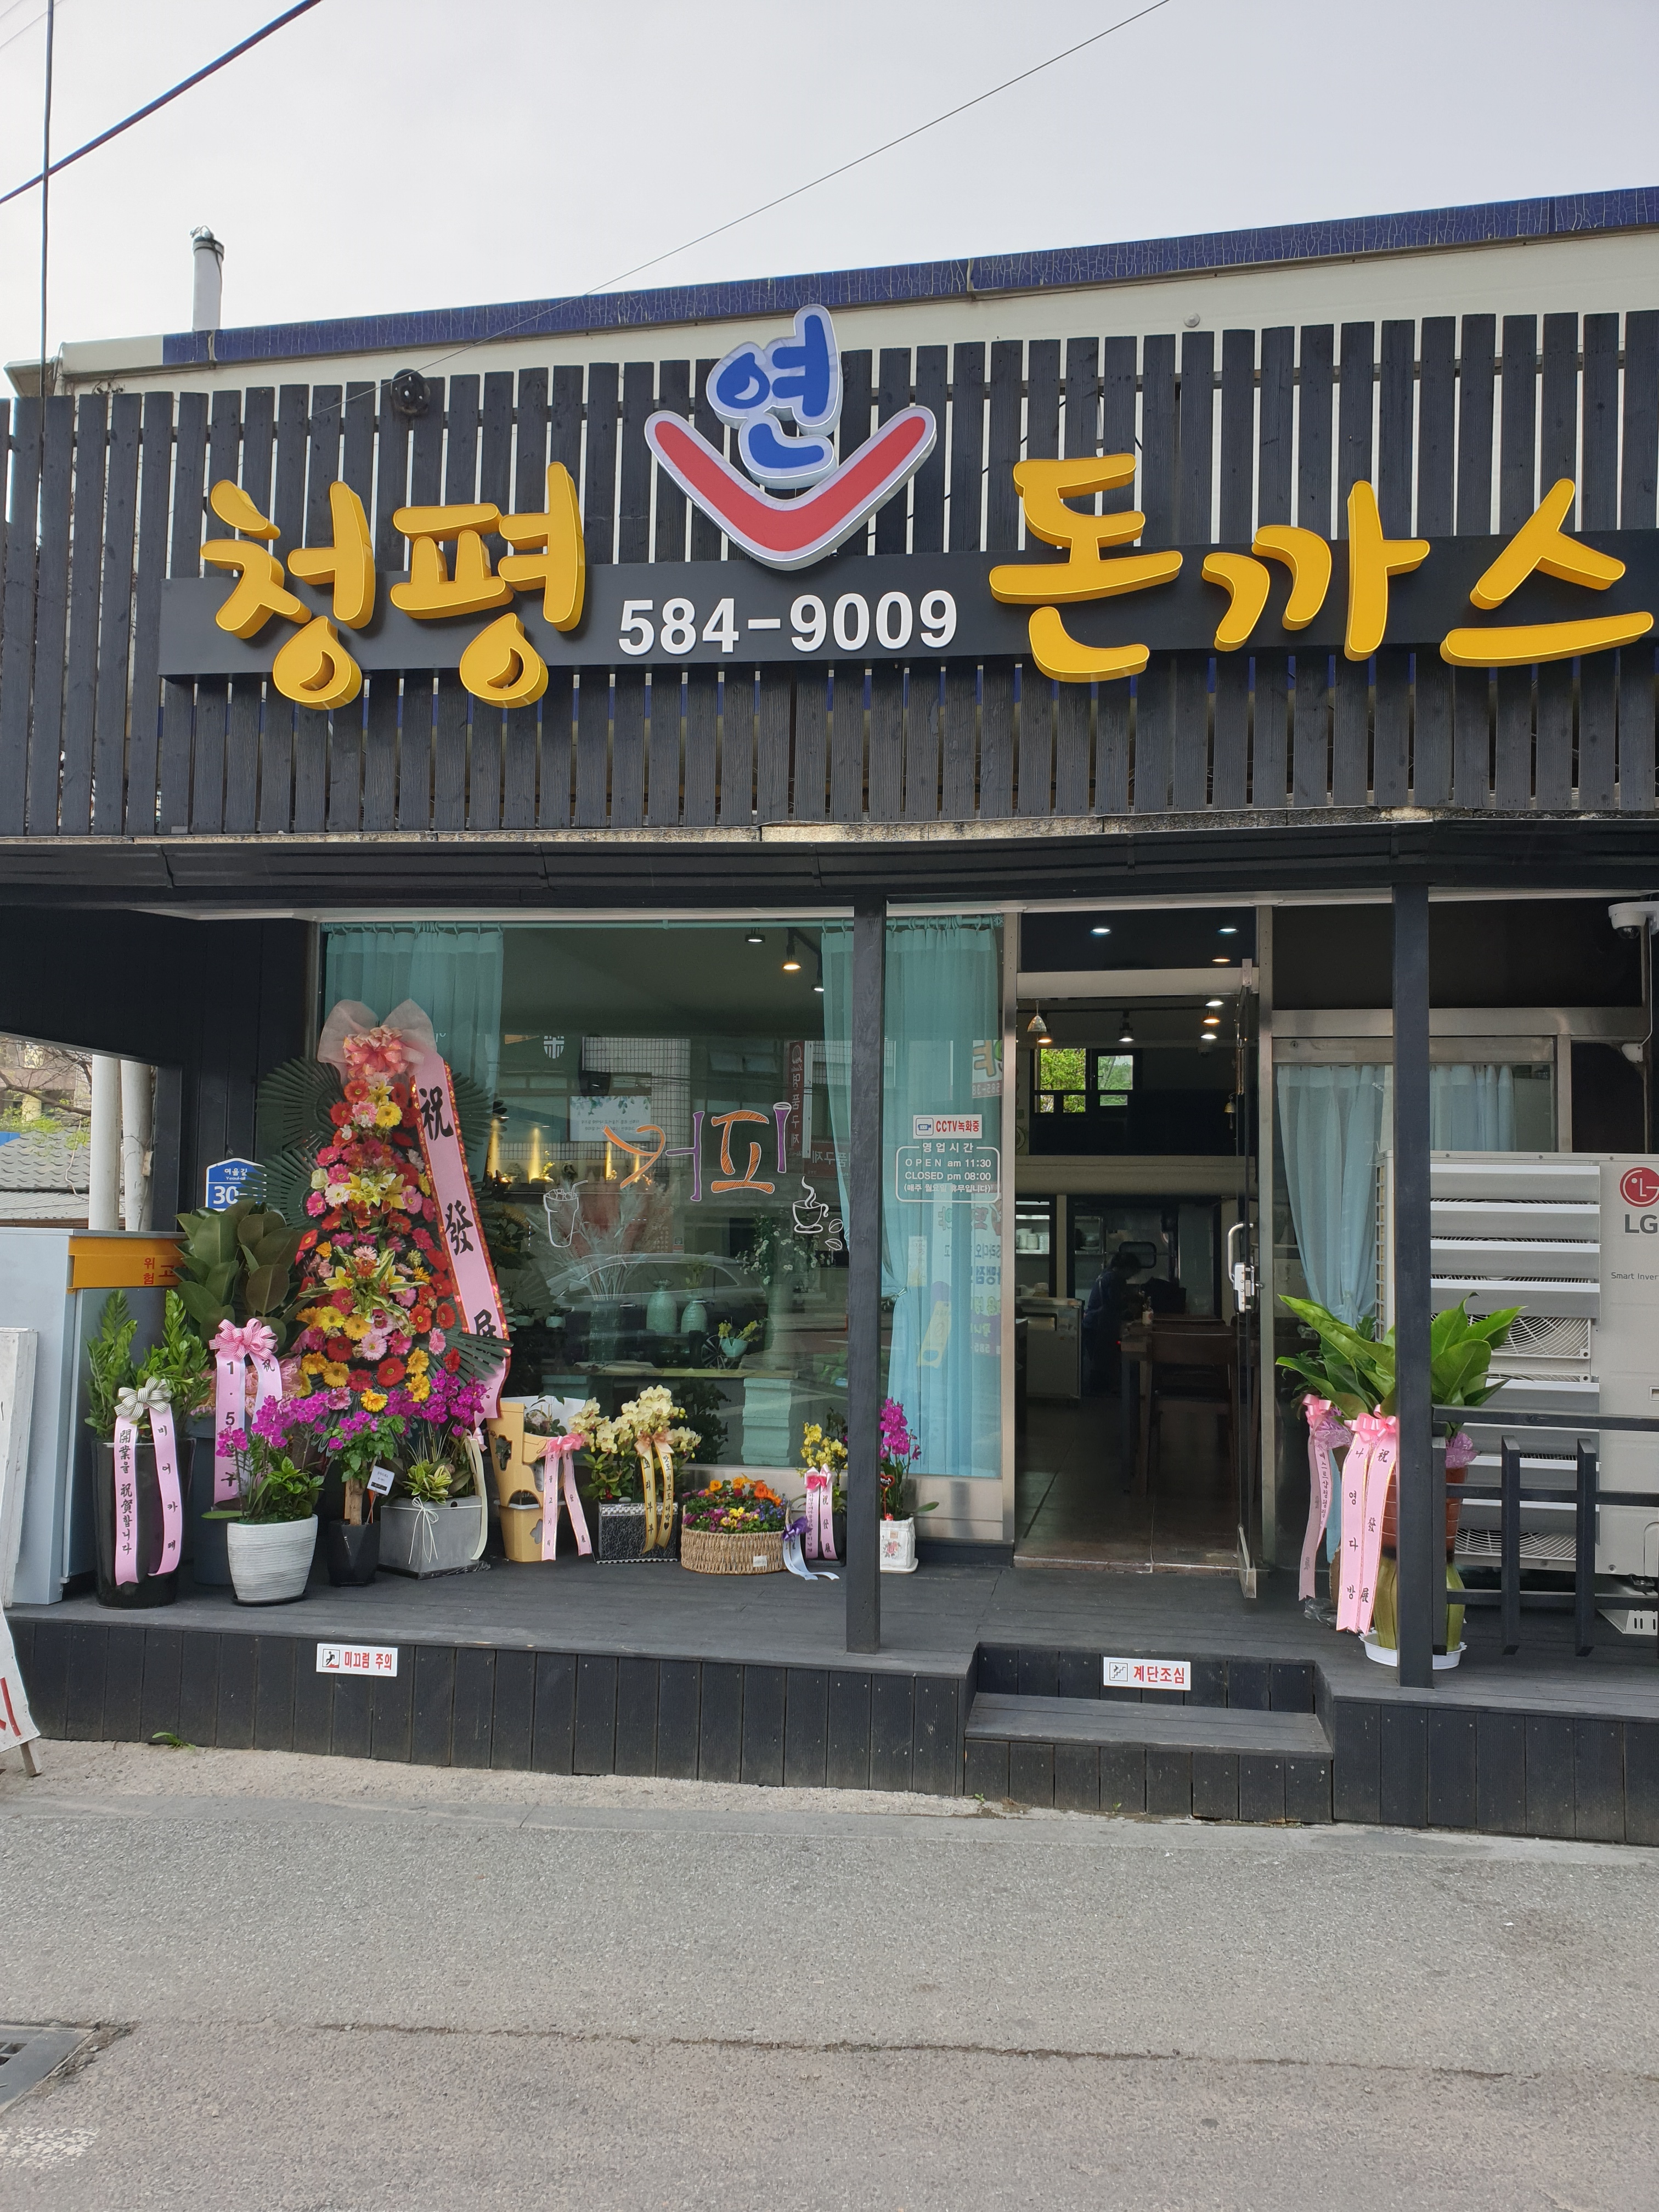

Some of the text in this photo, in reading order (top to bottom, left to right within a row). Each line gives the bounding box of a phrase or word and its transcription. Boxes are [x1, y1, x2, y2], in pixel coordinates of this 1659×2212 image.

[200, 461, 585, 709] 청평
[989, 452, 1655, 683] 돈까스
[618, 590, 957, 656] 584-9009
[603, 1102, 792, 1201] 커피
[922, 1142, 974, 1153] 영업시간
[224, 1168, 247, 1176] 여울길
[905, 1159, 941, 1167] OPEN
[965, 1159, 991, 1167] 11:30
[905, 1171, 943, 1180] CLOSED
[964, 1172, 991, 1181] 08:00
[904, 1183, 991, 1193] (매주 월요일 휴무입니다)
[1624, 1214, 1658, 1234] LG
[143, 1257, 155, 1285] 위험
[344, 1651, 392, 1670] 미끄럼 주의
[1133, 1665, 1185, 1684] 계단조심
